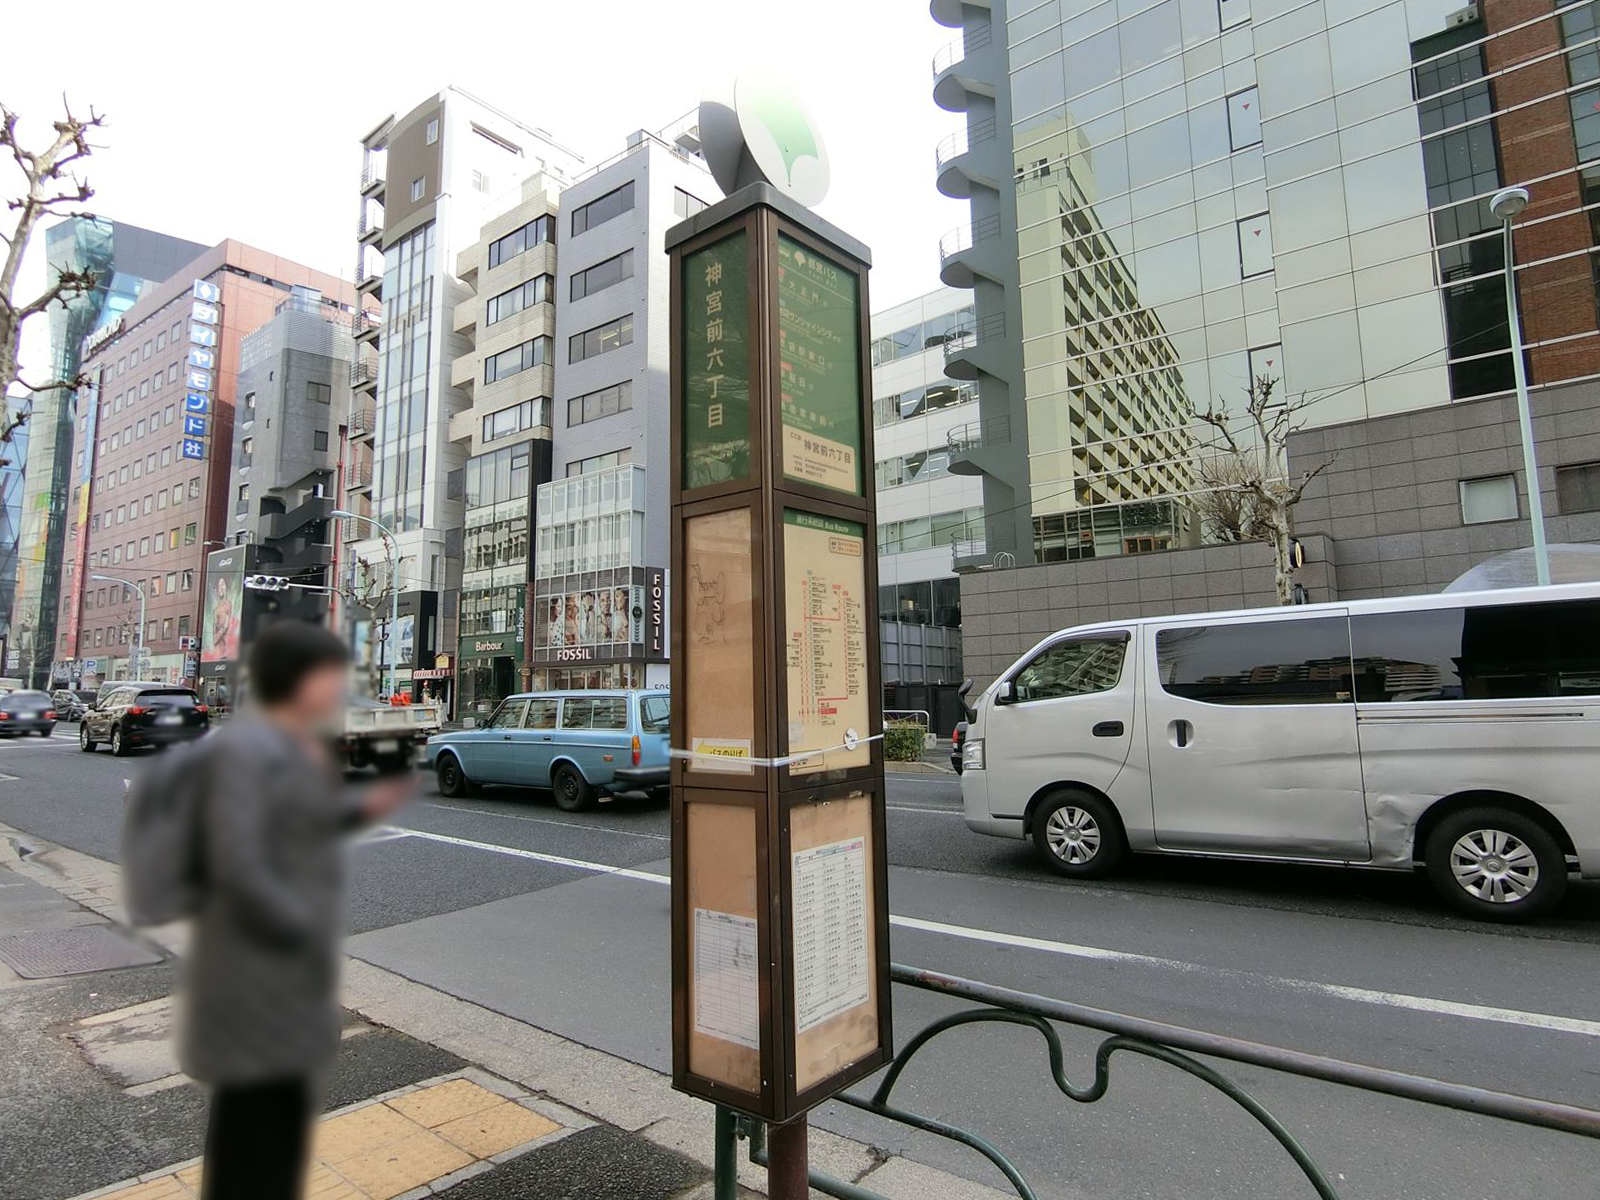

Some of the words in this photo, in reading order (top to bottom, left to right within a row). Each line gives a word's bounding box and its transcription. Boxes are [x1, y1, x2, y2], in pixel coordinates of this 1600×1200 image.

[705, 262, 724, 428] 神宮前六丁目
[184, 304, 214, 457] ダイヤモンド社
[803, 439, 851, 464] 神宮前六丁目
[516, 606, 525, 642] Barbour
[653, 574, 662, 650] FOSSIL
[475, 641, 503, 652] Barbour
[557, 648, 592, 661] FOSSIL
